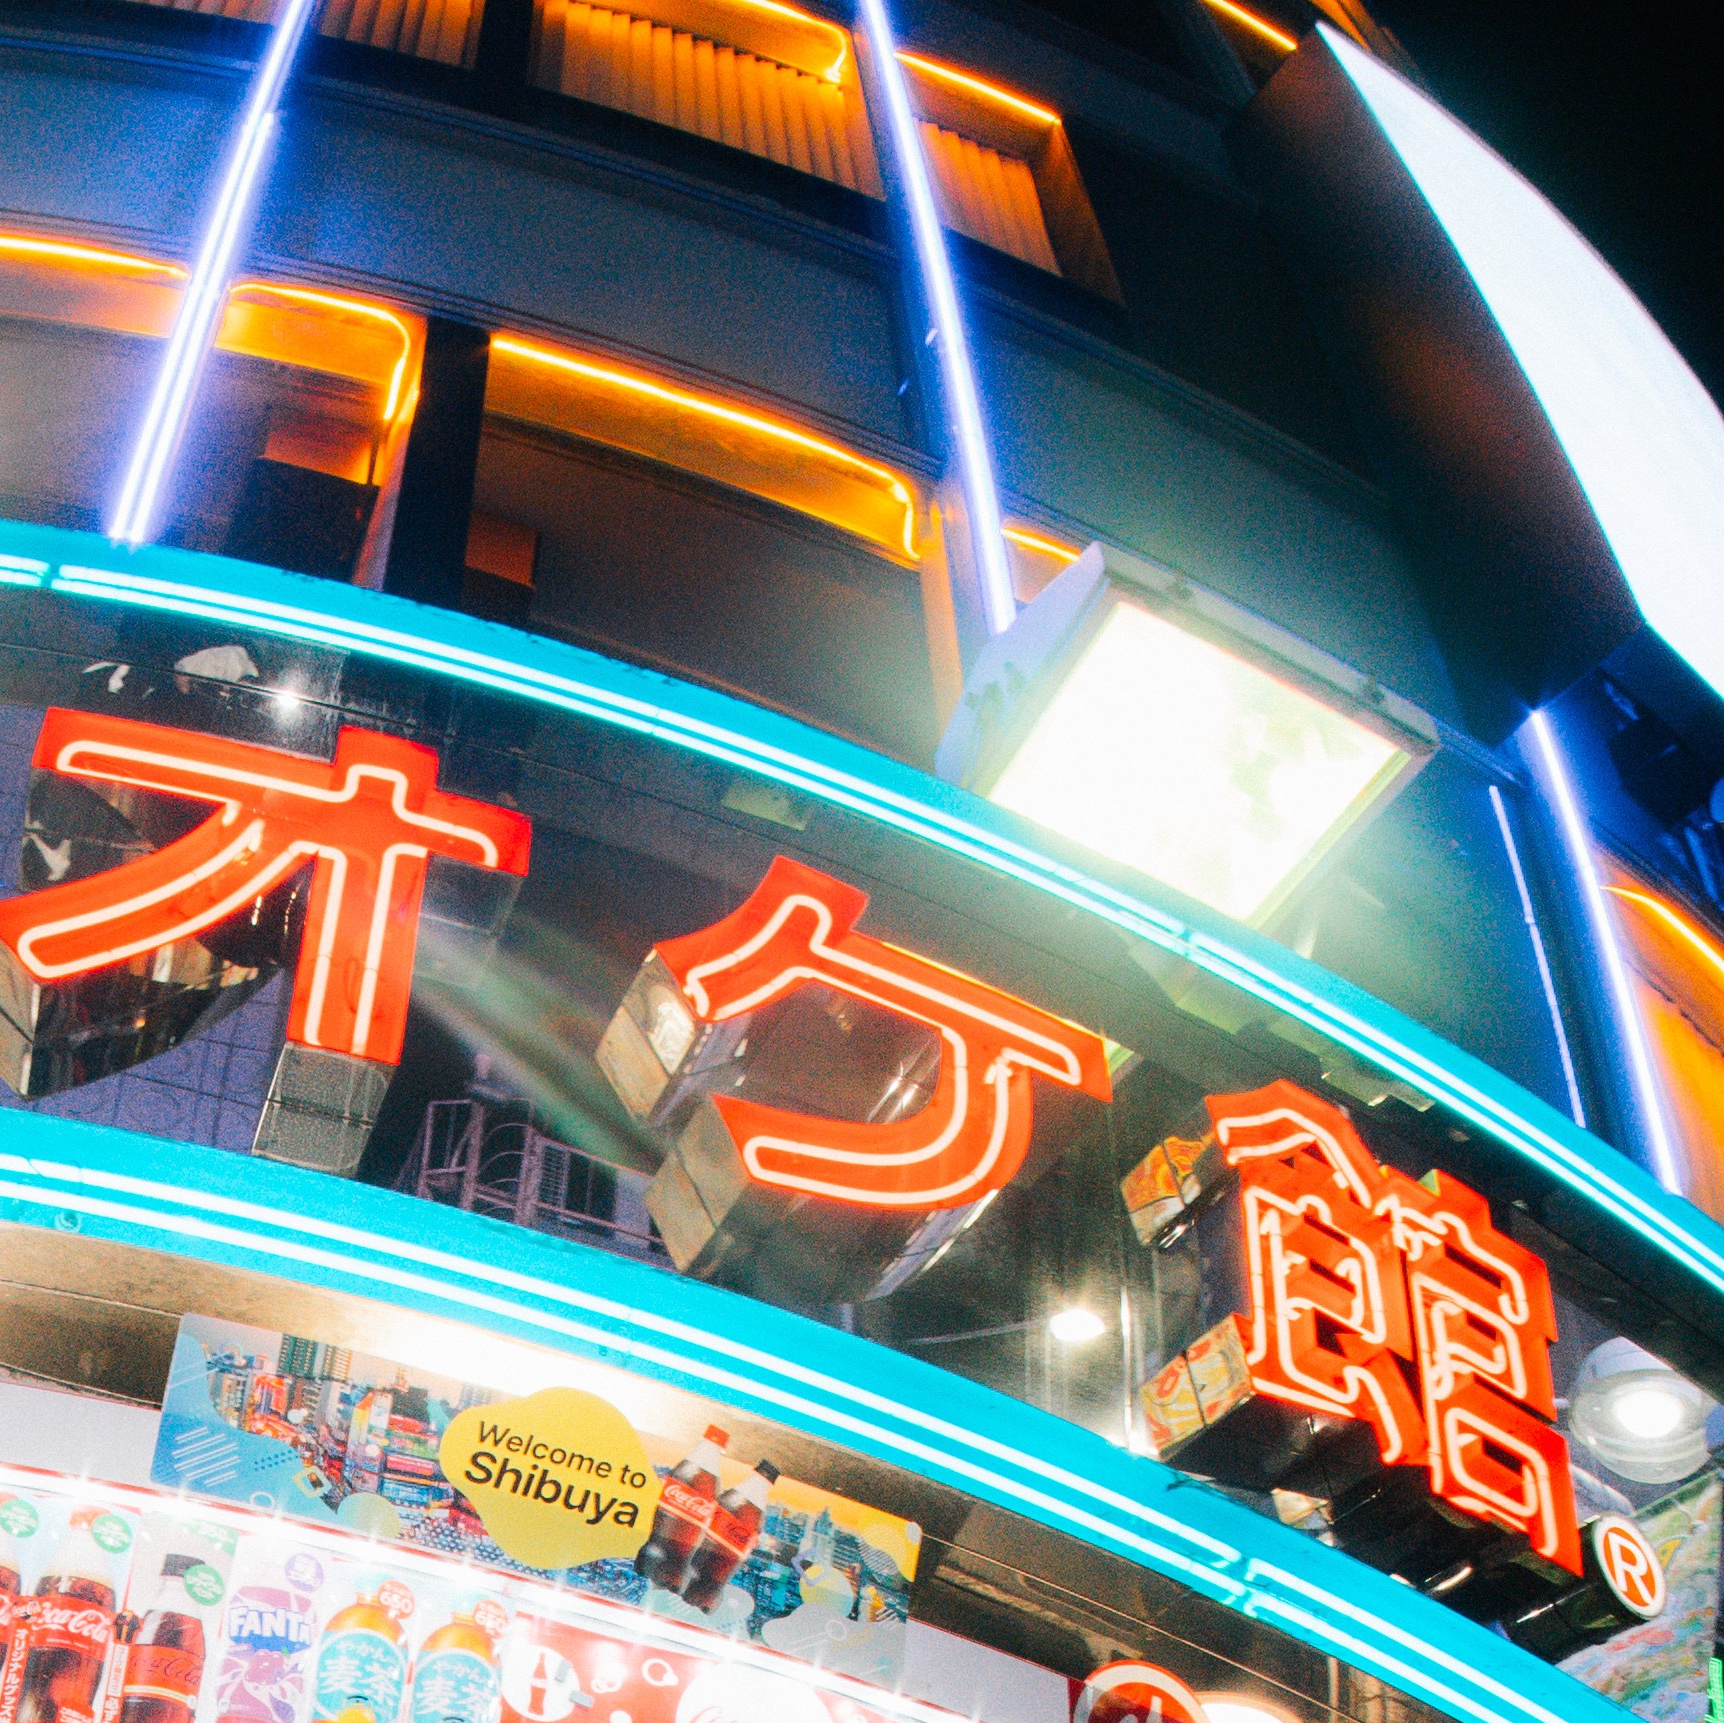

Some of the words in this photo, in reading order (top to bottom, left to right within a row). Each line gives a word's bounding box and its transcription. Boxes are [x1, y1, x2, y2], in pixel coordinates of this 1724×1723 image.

[477, 1420, 614, 1478] Welcome
[619, 1466, 649, 1490] to
[463, 1452, 643, 1532] Shibuya
[319, 1657, 401, 1707] 麦茶
[416, 1677, 490, 1722] 麦茶
